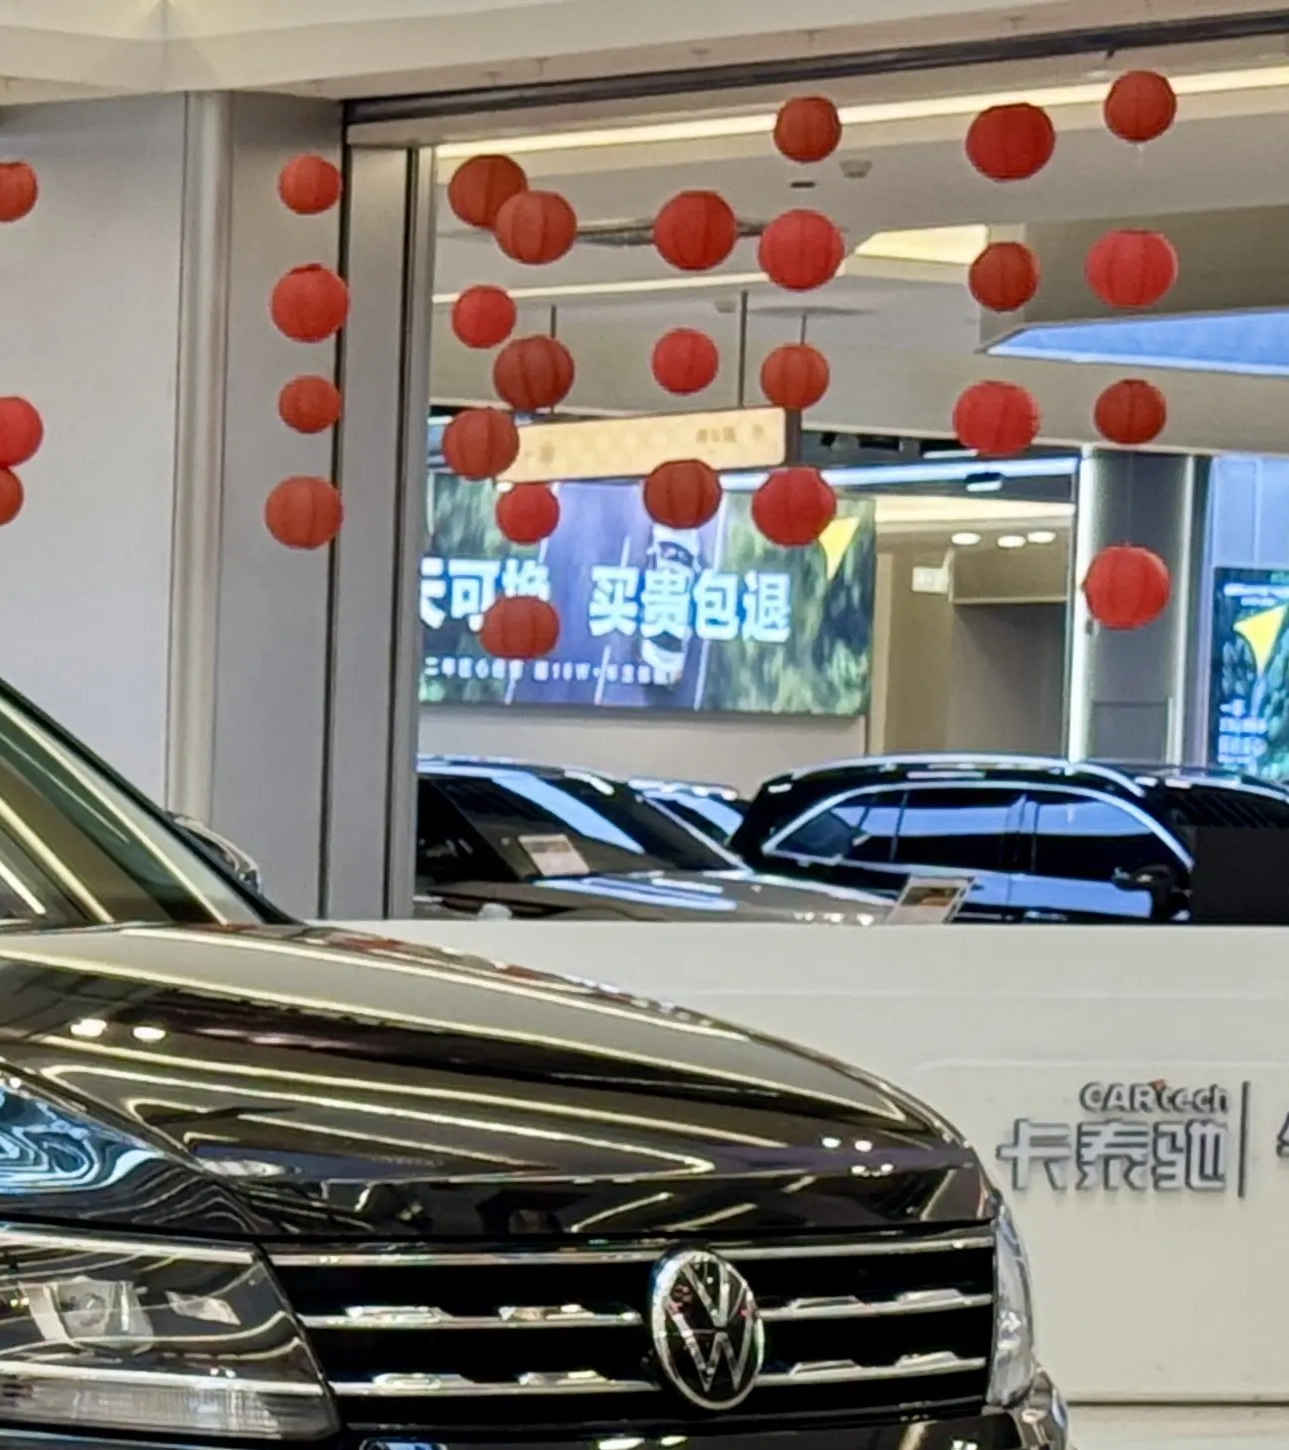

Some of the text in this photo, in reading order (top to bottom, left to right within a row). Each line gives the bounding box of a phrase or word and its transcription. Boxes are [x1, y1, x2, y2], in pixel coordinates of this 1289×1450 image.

[588, 565, 792, 643] 买贵包退
[1079, 1080, 1229, 1113] CARtech
[995, 1118, 1228, 1191] 卡泰驰
